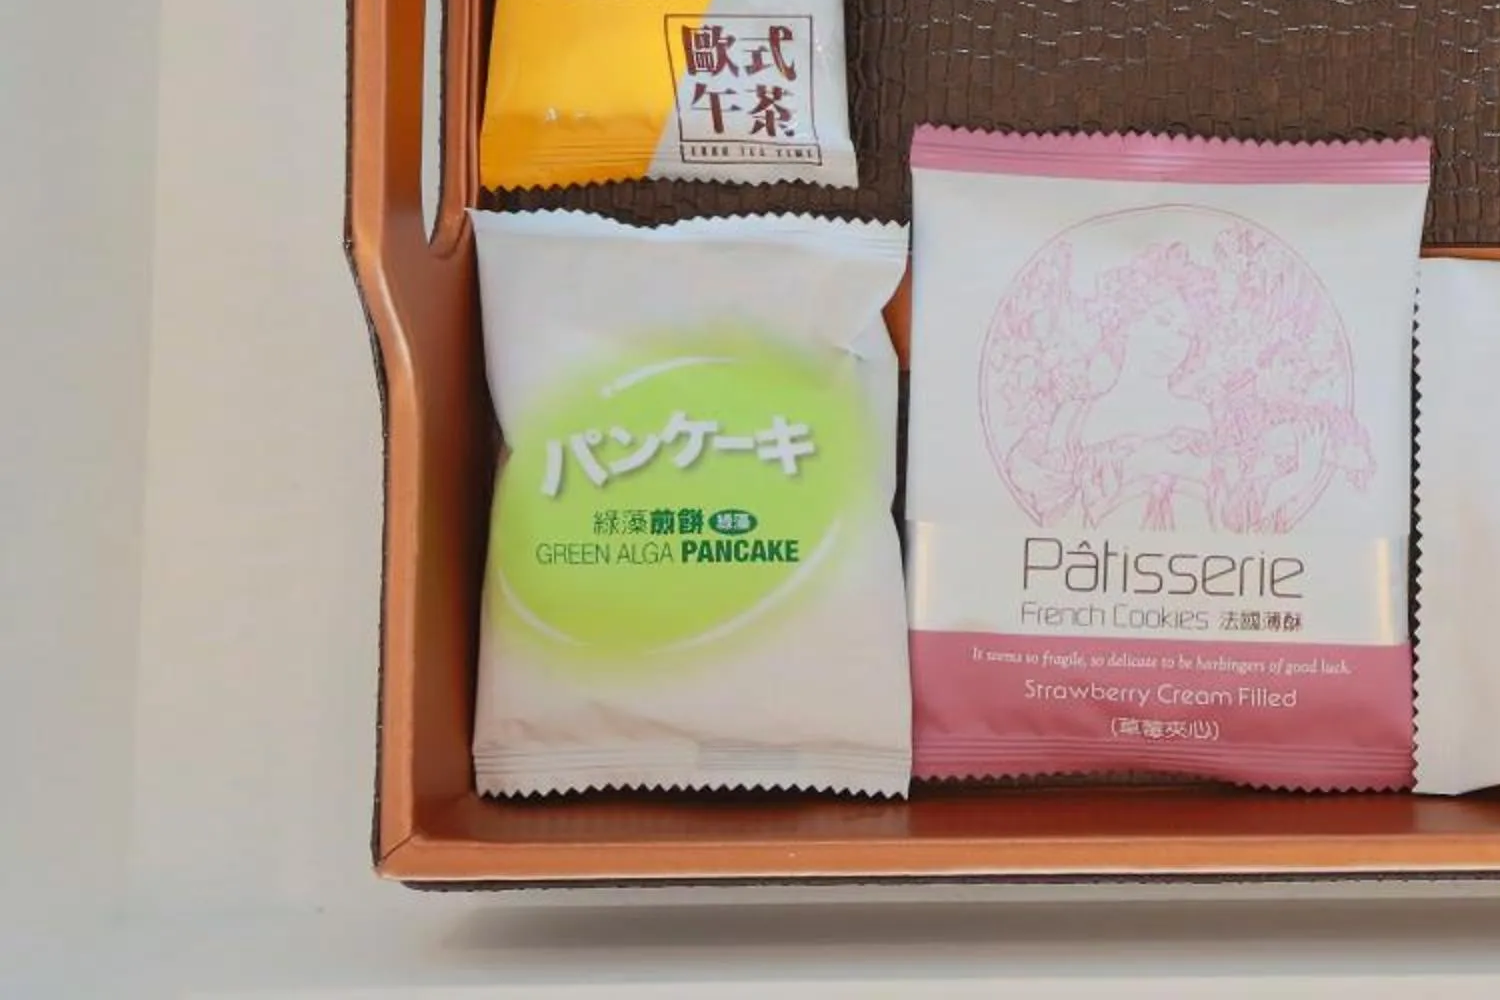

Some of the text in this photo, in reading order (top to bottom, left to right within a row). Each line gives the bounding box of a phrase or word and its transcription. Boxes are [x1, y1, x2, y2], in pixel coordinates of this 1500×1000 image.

[682, 25, 797, 82] 歐式
[691, 82, 797, 137] 午茶
[541, 410, 816, 497] パンケーキ
[536, 539, 800, 565] GREEN ALGA PANCAKE
[1023, 538, 1304, 598] Pâtisserie
[1021, 602, 1105, 627] French
[1113, 603, 1209, 631] Cookies
[973, 647, 983, 660] It
[1025, 654, 1039, 664] so
[1090, 655, 1104, 667] so
[1107, 651, 1157, 669] delicate
[1161, 655, 1175, 669] to
[1178, 654, 1193, 669] be
[1196, 656, 1265, 675] harbingers
[1269, 658, 1284, 675] of
[1285, 658, 1317, 677] good
[1025, 679, 1297, 708] Strawberry Cream Filled
